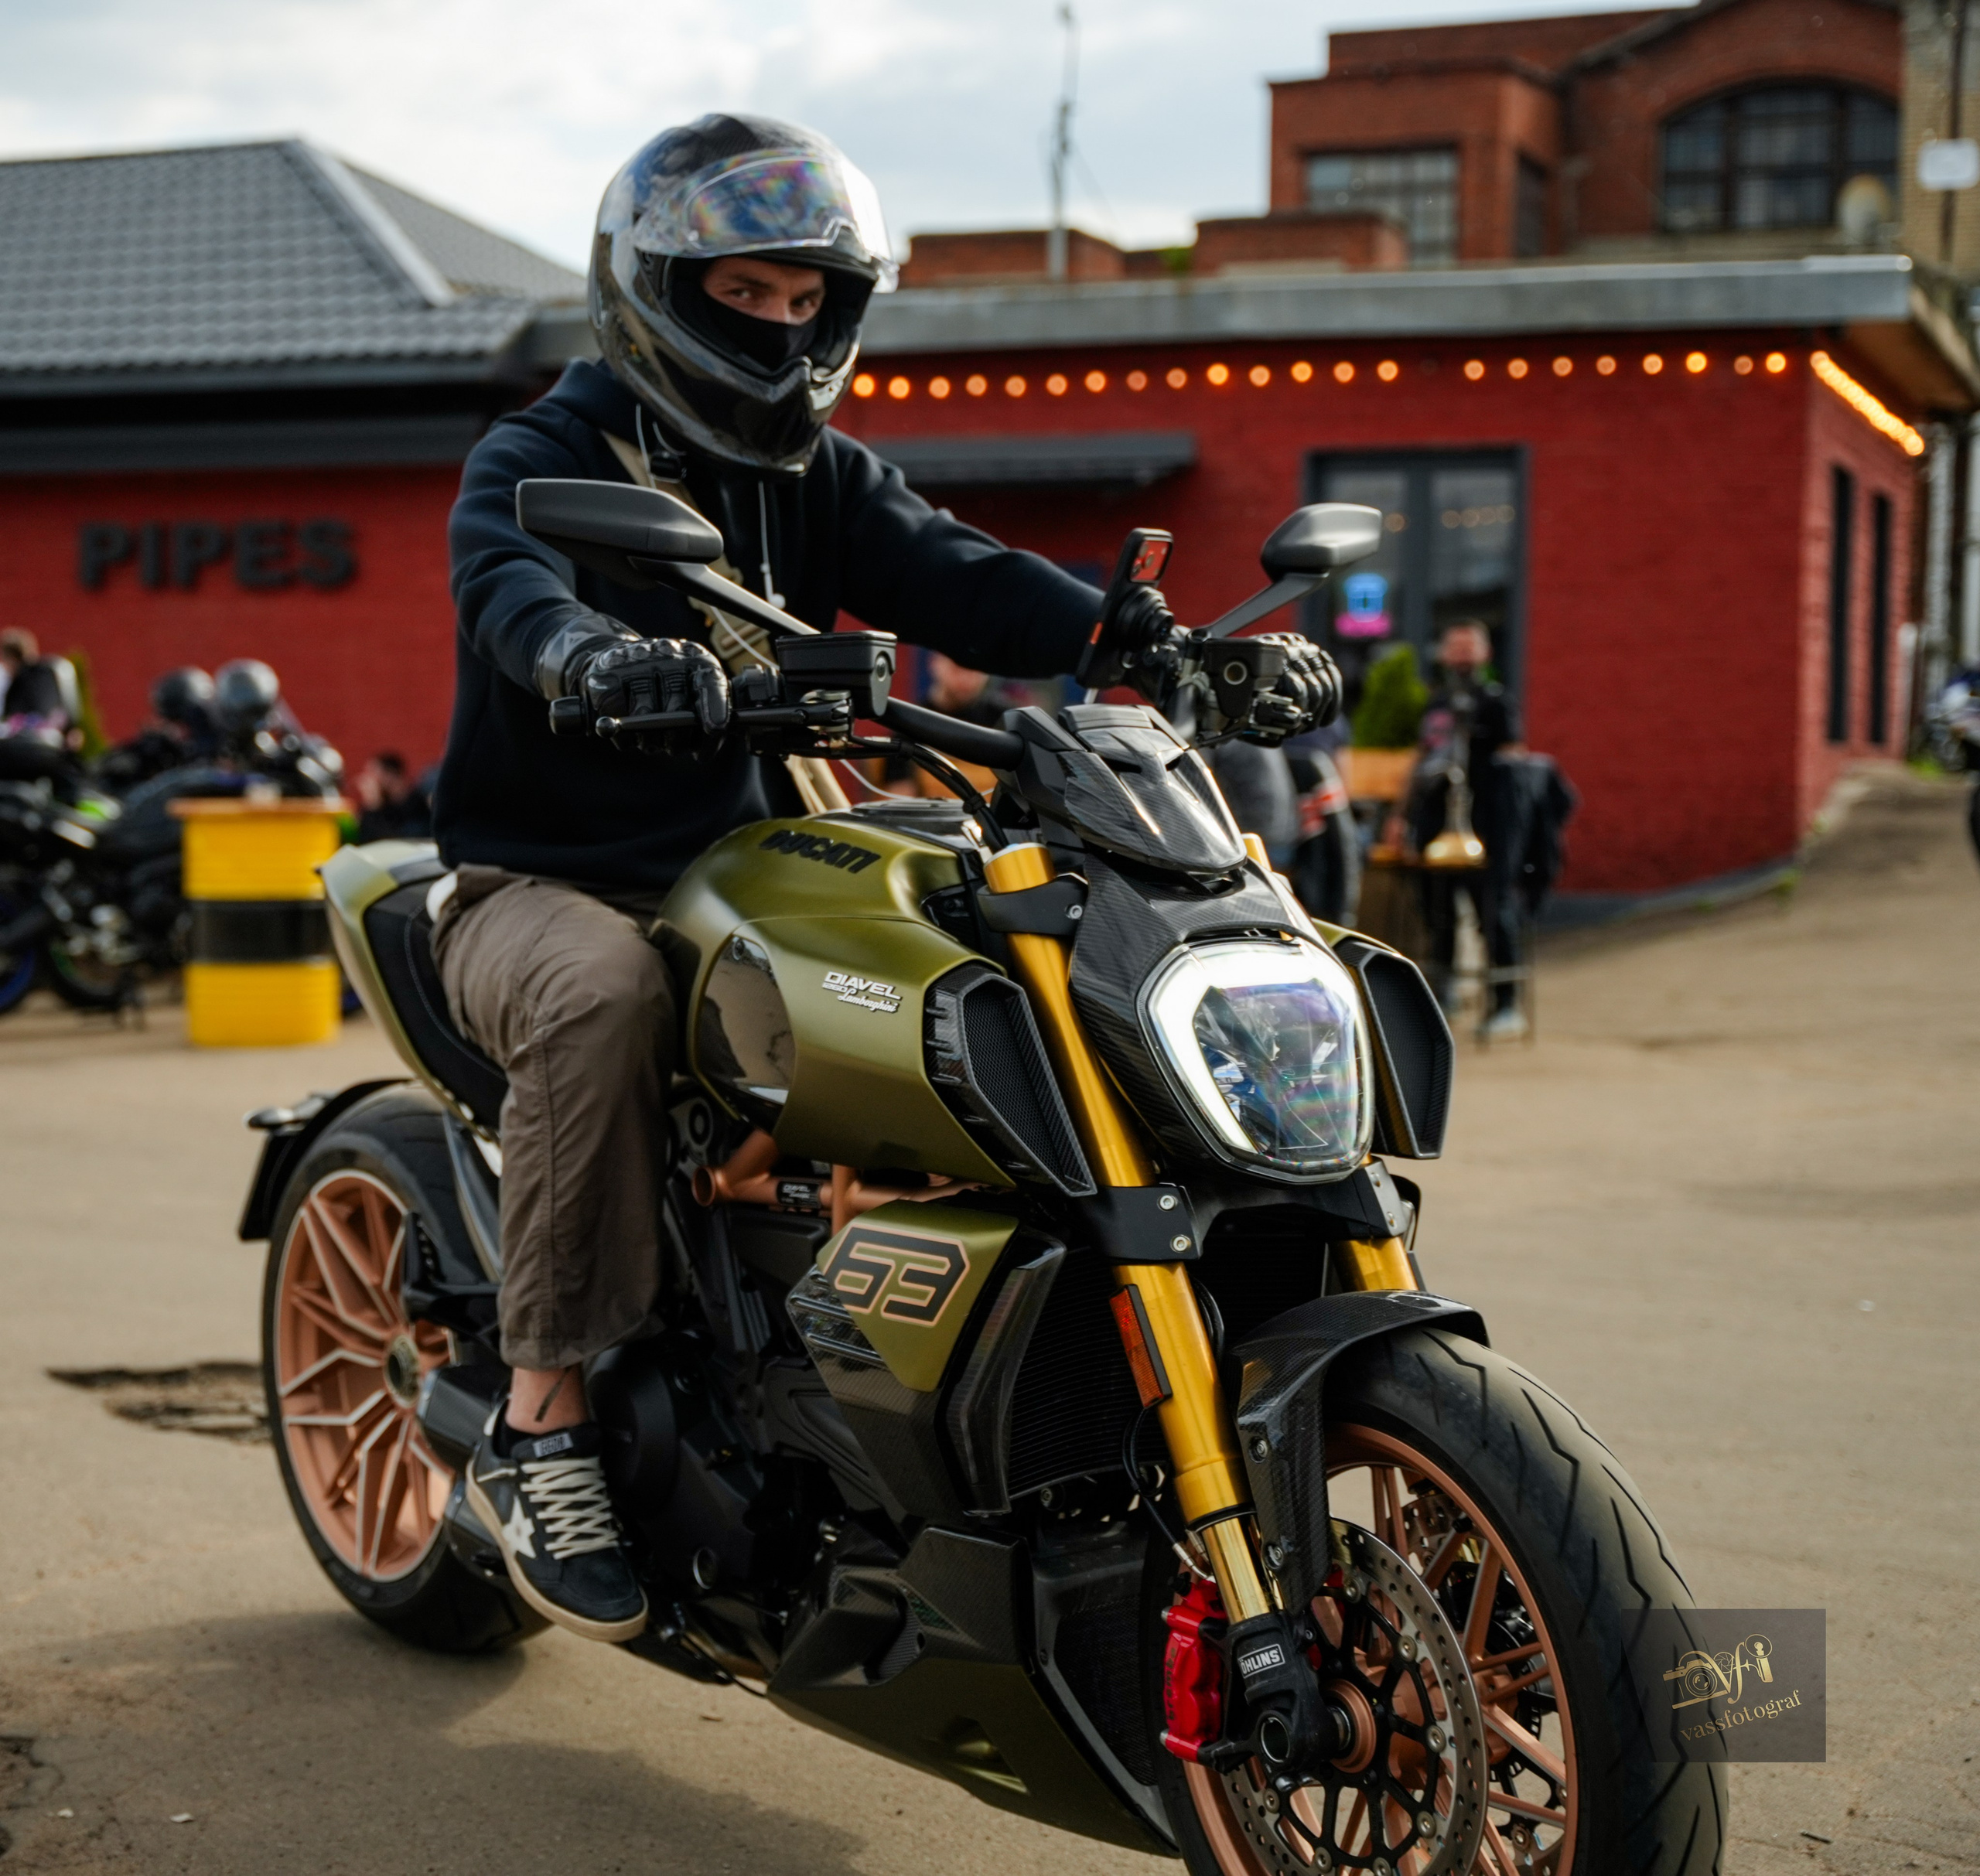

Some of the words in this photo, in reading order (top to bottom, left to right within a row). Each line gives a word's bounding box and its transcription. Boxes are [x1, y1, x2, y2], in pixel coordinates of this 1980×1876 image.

[77, 518, 359, 592] PIPES
[759, 830, 881, 874] DUCATI
[824, 971, 902, 1001] DIAVEL
[837, 987, 899, 1013] Lamborghini
[822, 1223, 971, 1328] 63
[1239, 1649, 1281, 1674] ÖHLINS
